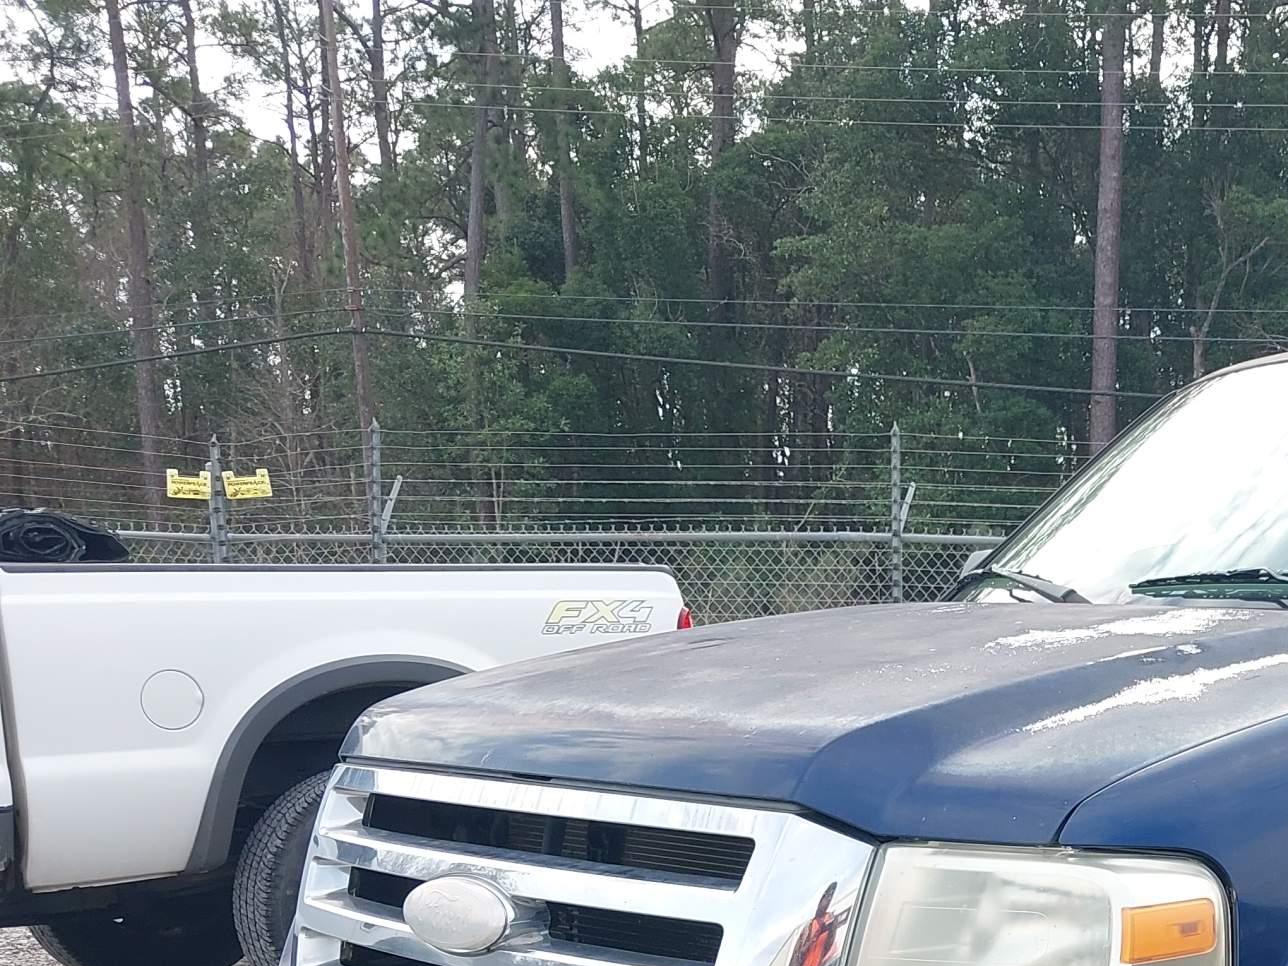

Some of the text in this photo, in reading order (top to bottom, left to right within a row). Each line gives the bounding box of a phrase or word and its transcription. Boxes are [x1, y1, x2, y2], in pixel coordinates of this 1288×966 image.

[545, 599, 654, 624] FX4
[541, 622, 652, 635] OFF ROAD
